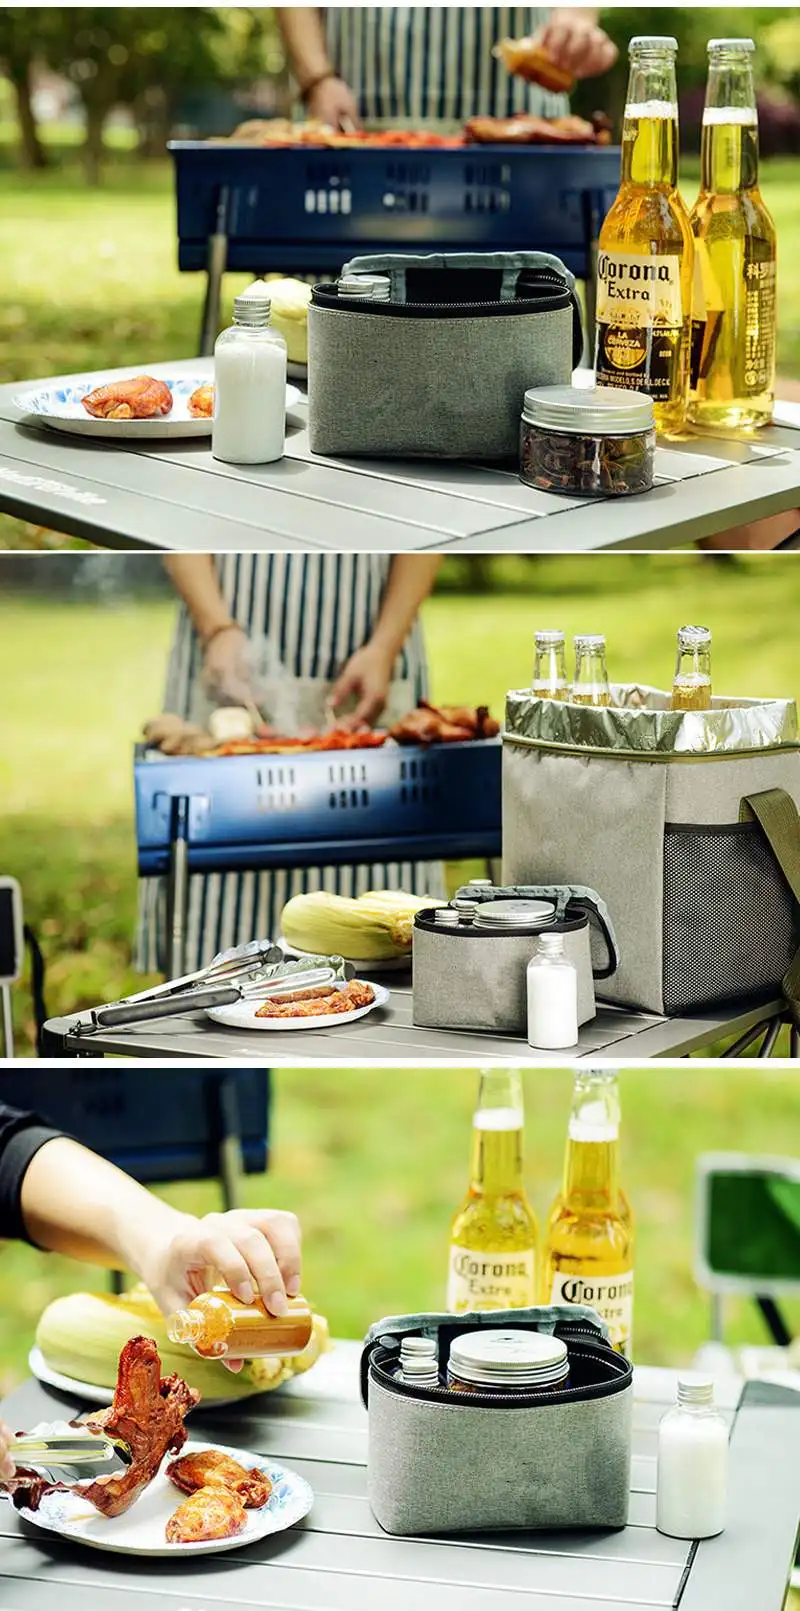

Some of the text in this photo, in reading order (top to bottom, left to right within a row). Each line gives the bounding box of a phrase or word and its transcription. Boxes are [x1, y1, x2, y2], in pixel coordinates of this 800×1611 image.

[598, 254, 670, 285] Corona
[607, 280, 650, 300] Extra
[617, 331, 628, 339] LA
[453, 1253, 527, 1279] Corona
